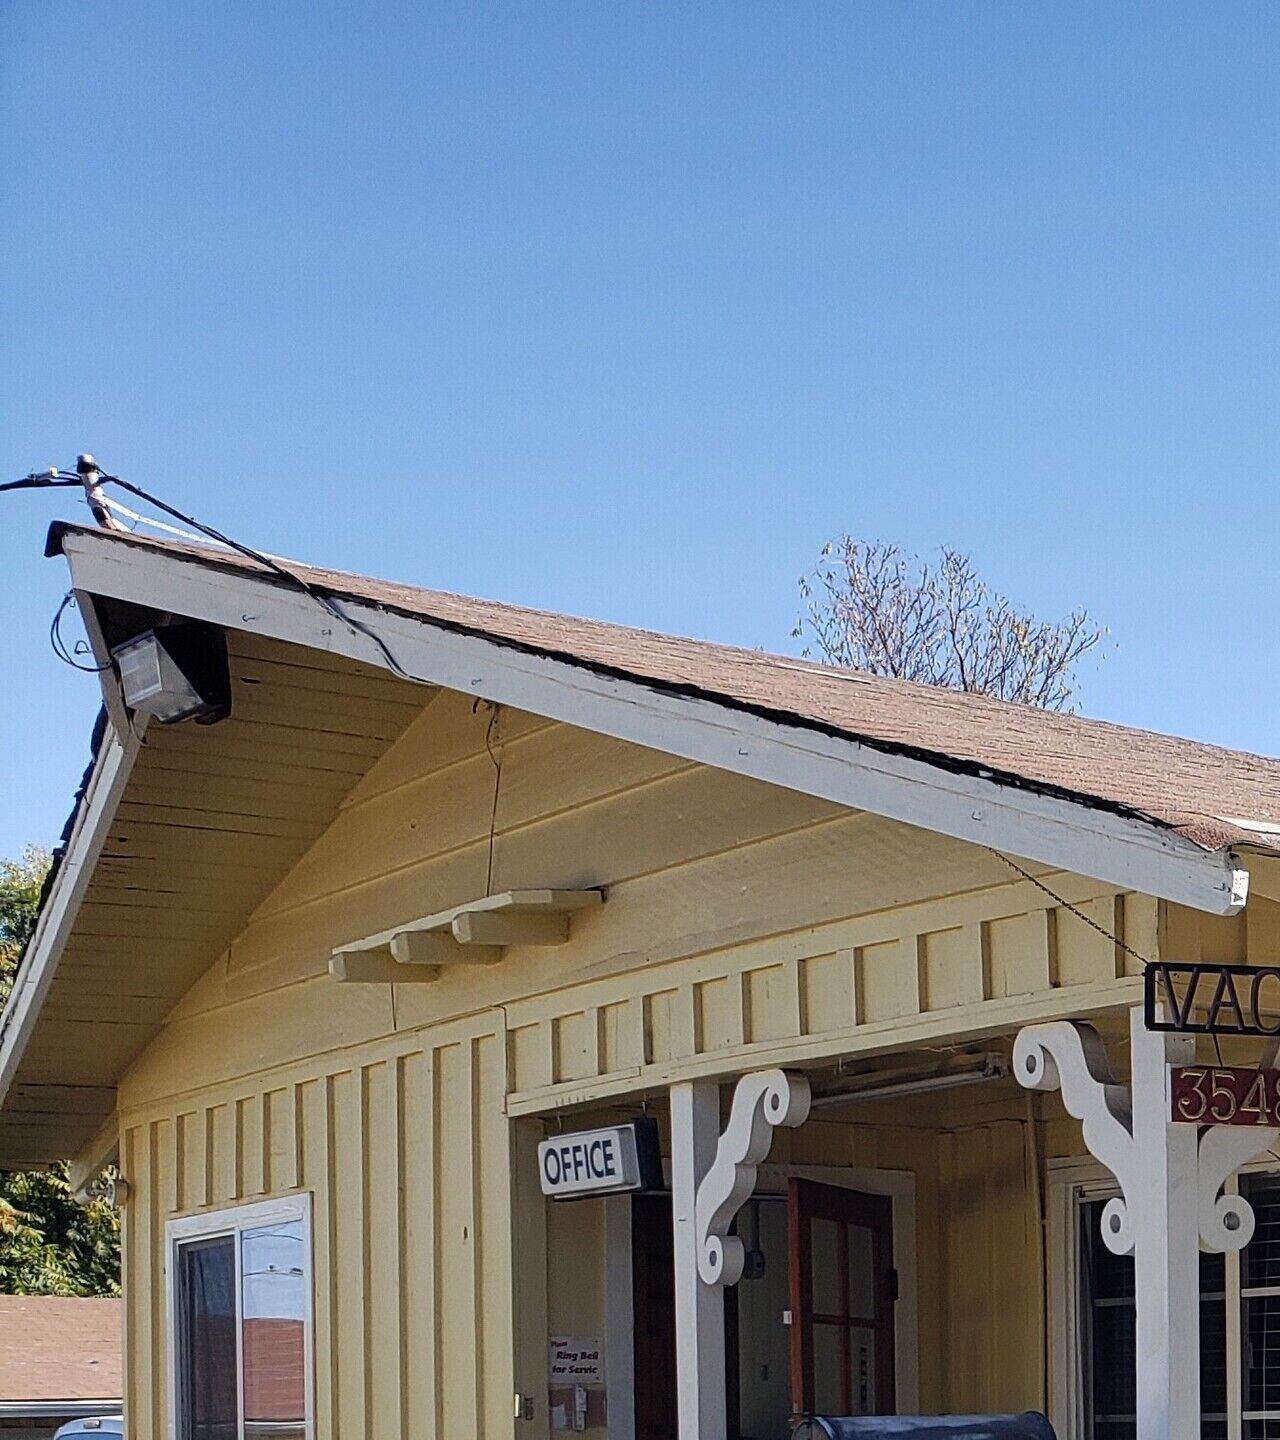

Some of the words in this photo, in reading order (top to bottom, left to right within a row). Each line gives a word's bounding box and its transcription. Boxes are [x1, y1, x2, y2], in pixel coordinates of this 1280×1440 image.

[544, 1139, 616, 1185] OFFICE
[556, 1351, 578, 1361] Ring
[580, 1351, 599, 1360] Bell
